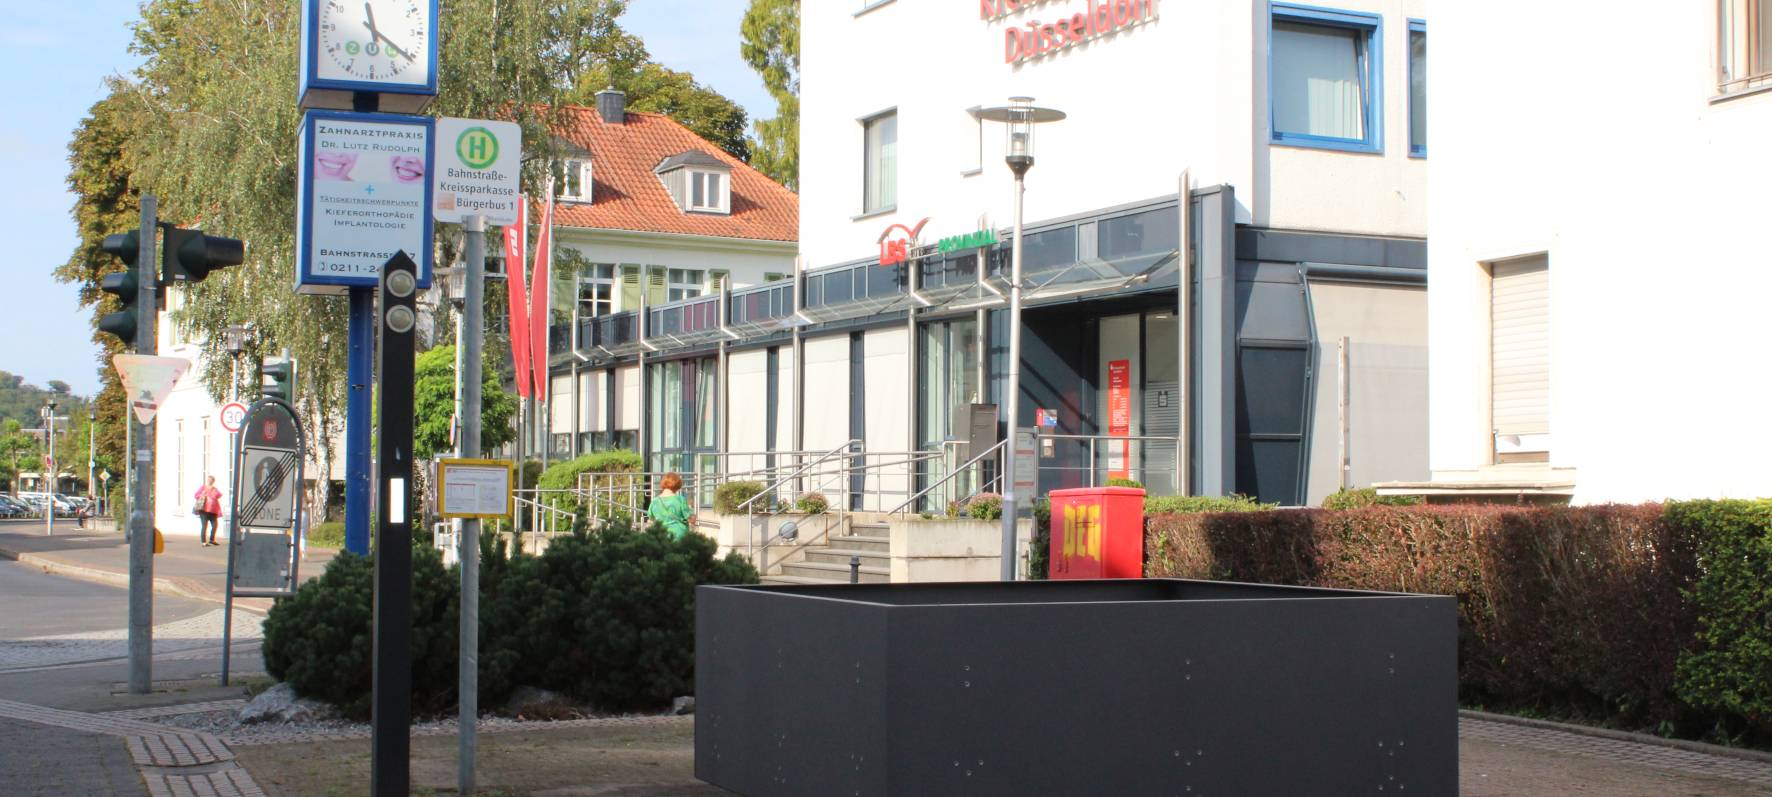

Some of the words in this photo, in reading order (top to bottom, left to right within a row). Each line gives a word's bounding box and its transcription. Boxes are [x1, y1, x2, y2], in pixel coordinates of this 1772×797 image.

[469, 135, 486, 160] H
[447, 168, 508, 181] Bahnstraße-
[440, 181, 514, 196] Kreissparkasse
[456, 198, 506, 210] Bürgerbus
[509, 201, 514, 210] 1
[320, 249, 393, 259] BAHNSTRASS
[226, 411, 242, 424] 30
